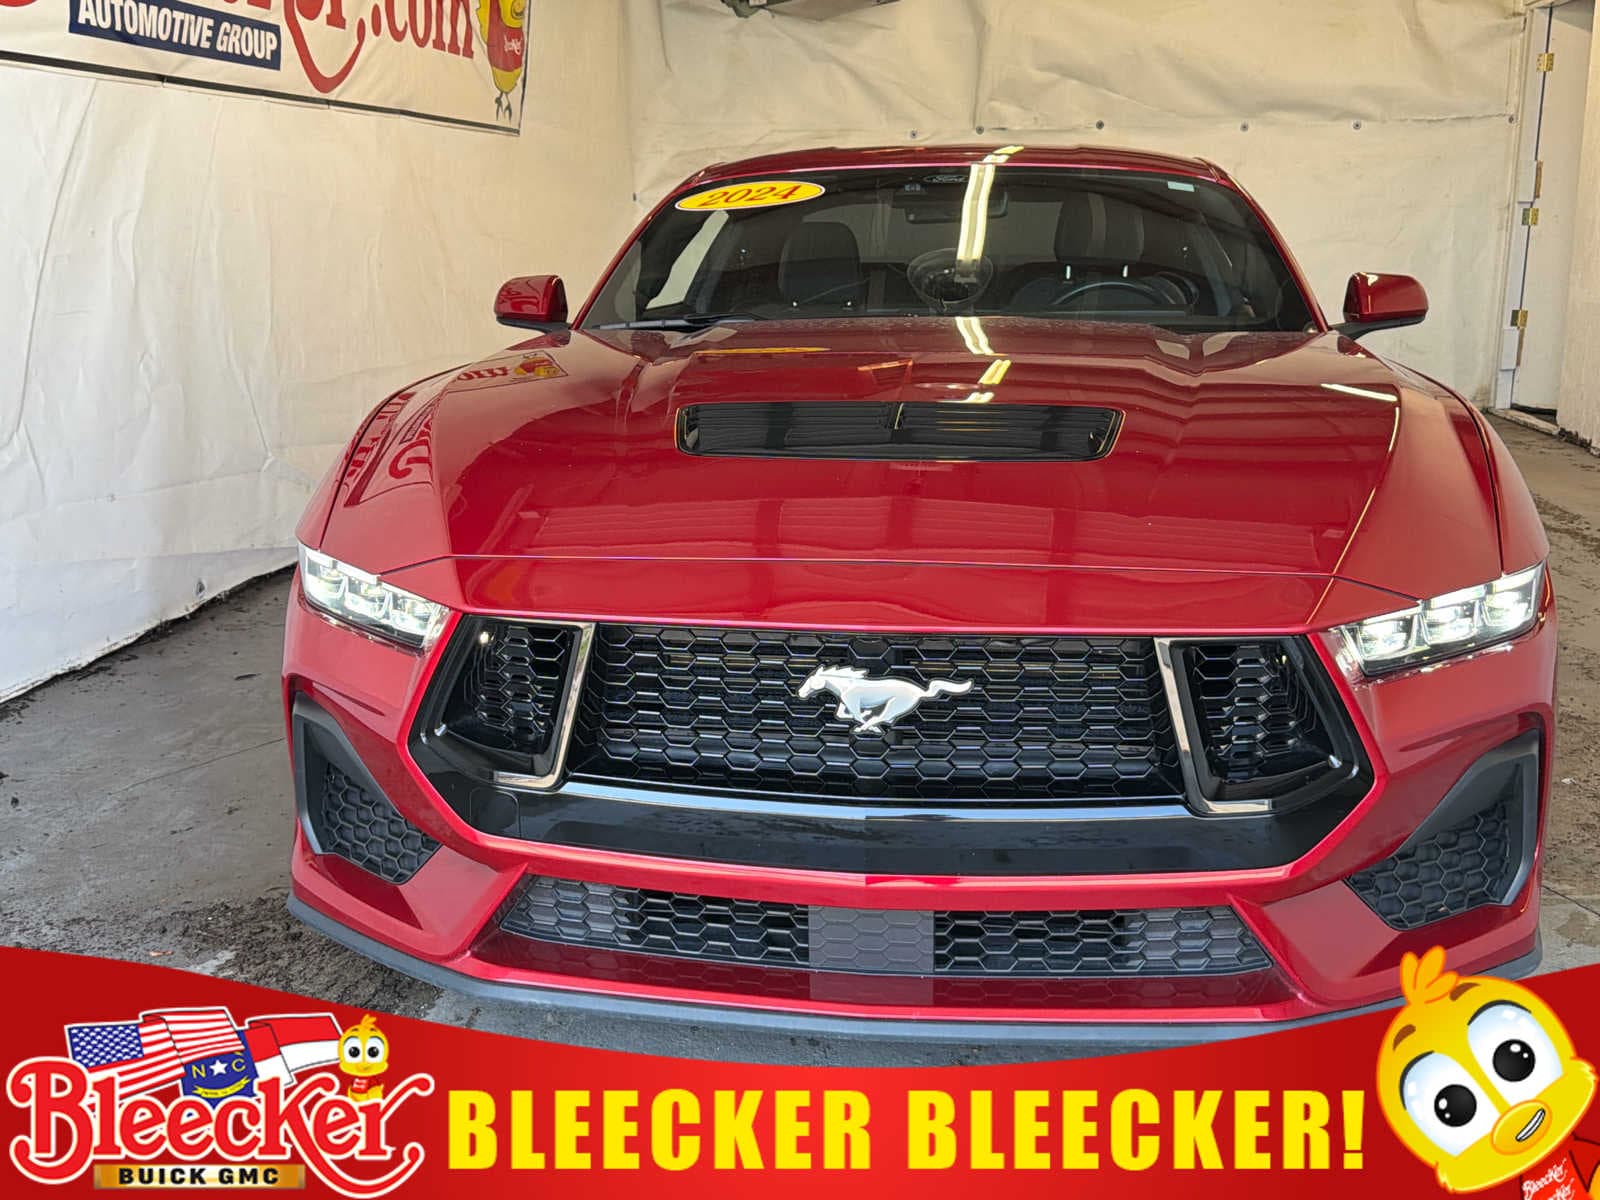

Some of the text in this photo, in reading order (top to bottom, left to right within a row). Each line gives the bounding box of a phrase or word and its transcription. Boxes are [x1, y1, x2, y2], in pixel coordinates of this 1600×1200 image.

[78, 0, 278, 60] AUTOMOTIVE GROUP
[698, 185, 801, 207] 2024
